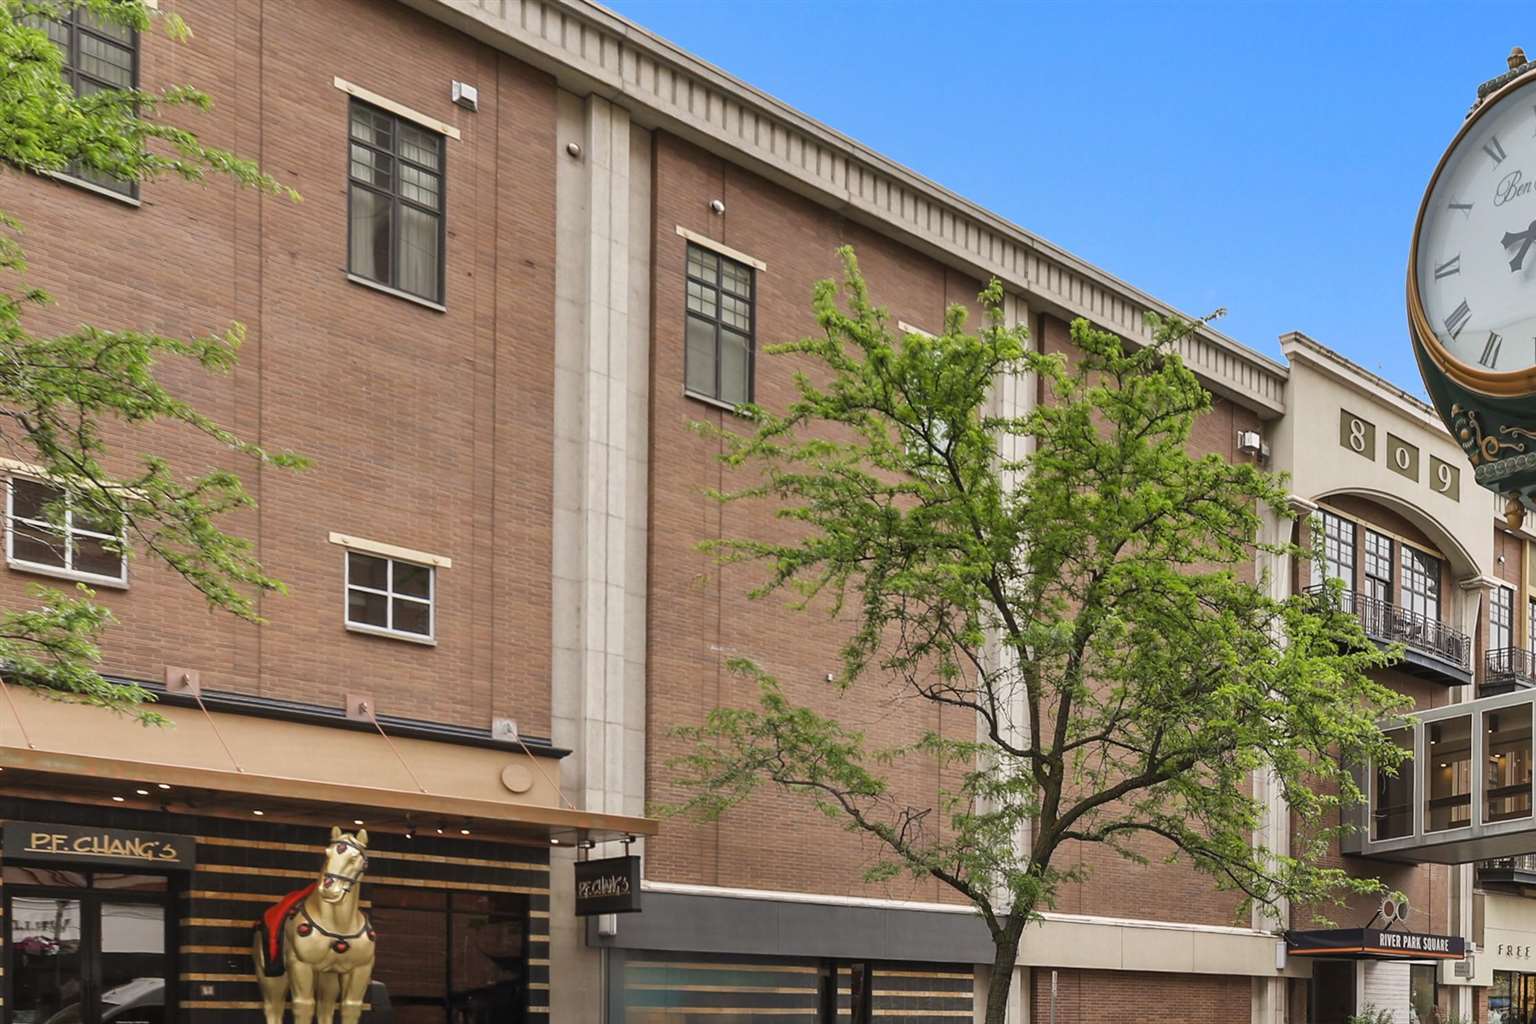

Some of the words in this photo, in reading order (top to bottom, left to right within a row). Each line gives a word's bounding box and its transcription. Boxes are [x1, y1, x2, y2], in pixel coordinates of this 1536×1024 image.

[1493, 169, 1532, 207] Ben
[1349, 418, 1452, 492] 809
[30, 832, 69, 853] P.F.
[1379, 933, 1401, 948] RIVER
[1403, 935, 1422, 950] PARK
[1423, 937, 1449, 952] SQUARE
[1497, 943, 1532, 959] FREE
